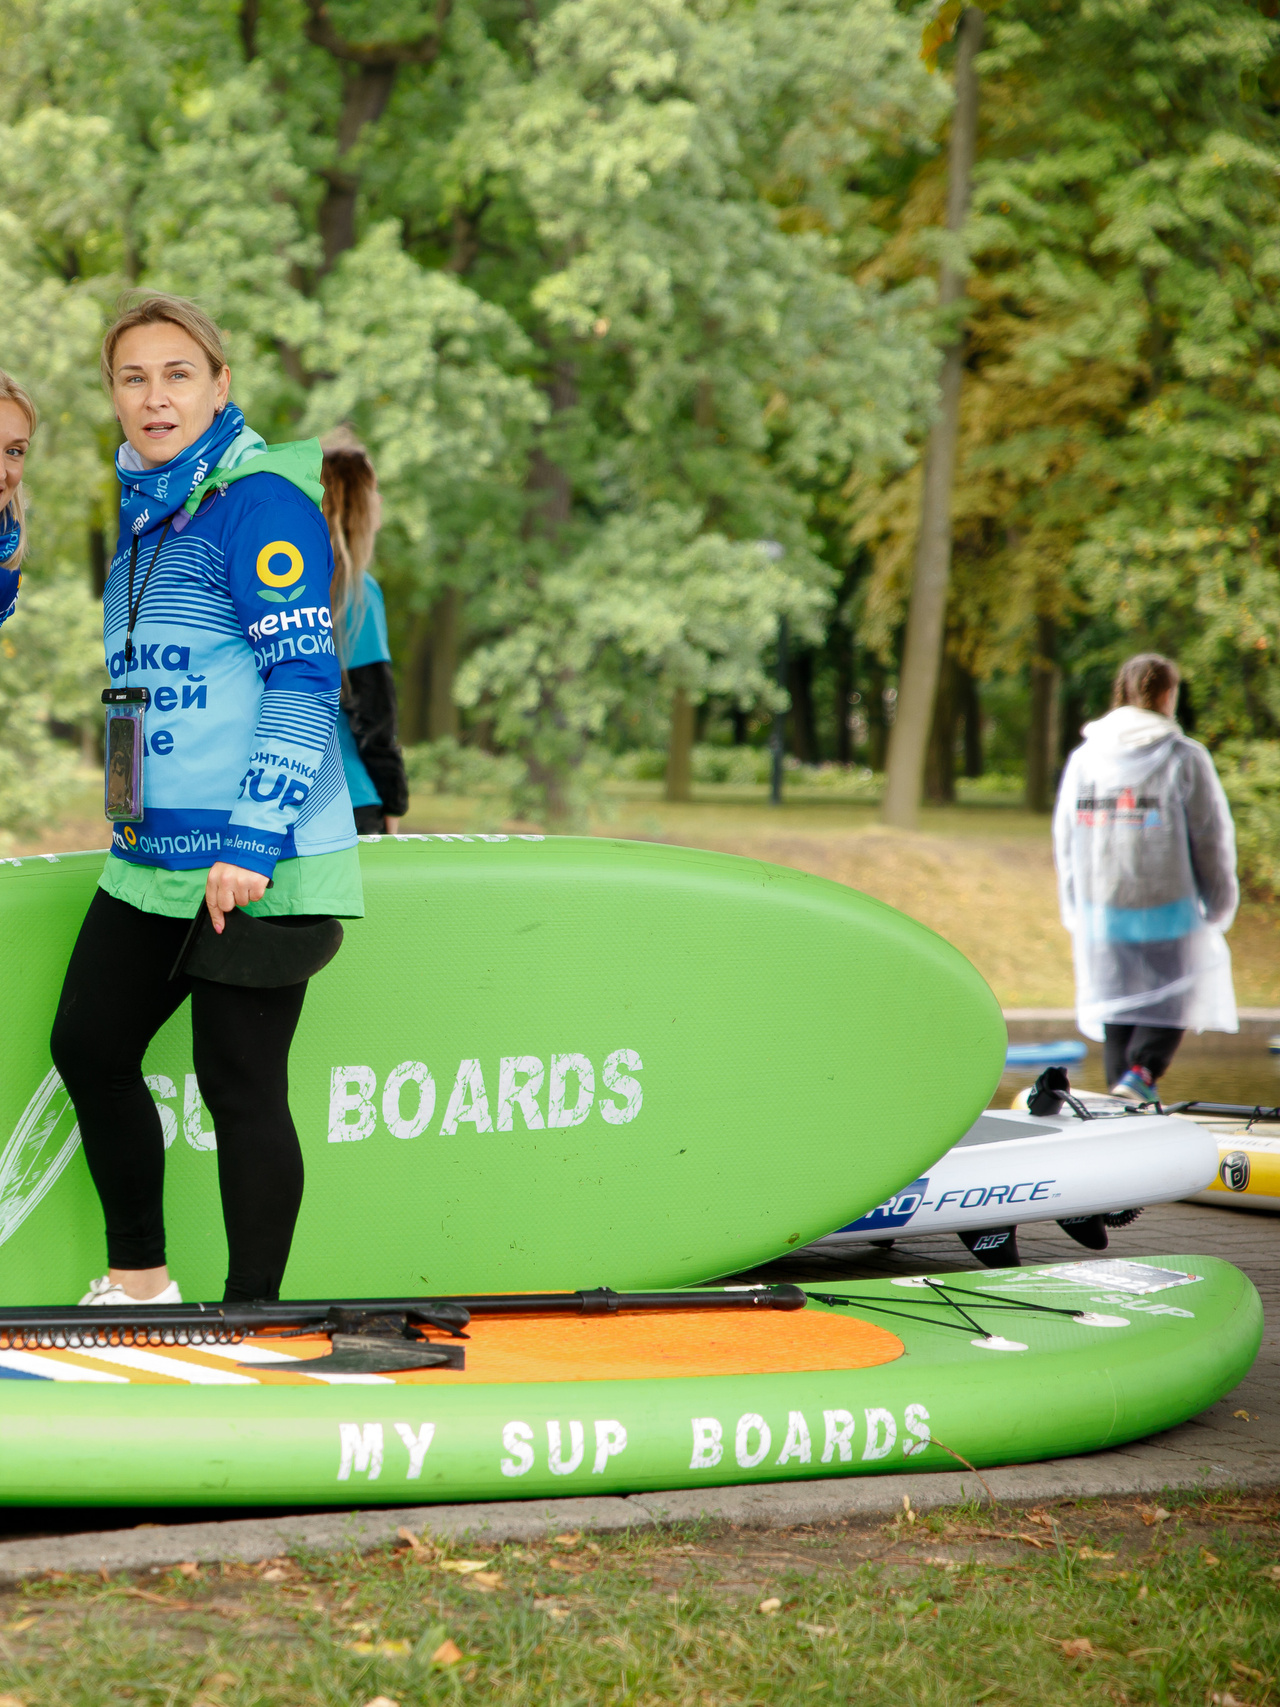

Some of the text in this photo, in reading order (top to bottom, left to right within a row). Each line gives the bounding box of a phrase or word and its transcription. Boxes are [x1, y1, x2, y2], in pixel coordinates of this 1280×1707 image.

[248, 606, 333, 643] лента
[105, 643, 191, 679] авка
[254, 629, 335, 671] онлай
[144, 674, 208, 713] ей
[139, 829, 221, 854] онлайн
[326, 1048, 644, 1144] BOARDS
[973, 1233, 1010, 1250] HF
[1089, 1294, 1195, 1318] SUP
[336, 1402, 932, 1481] MY SUP BOARDS
